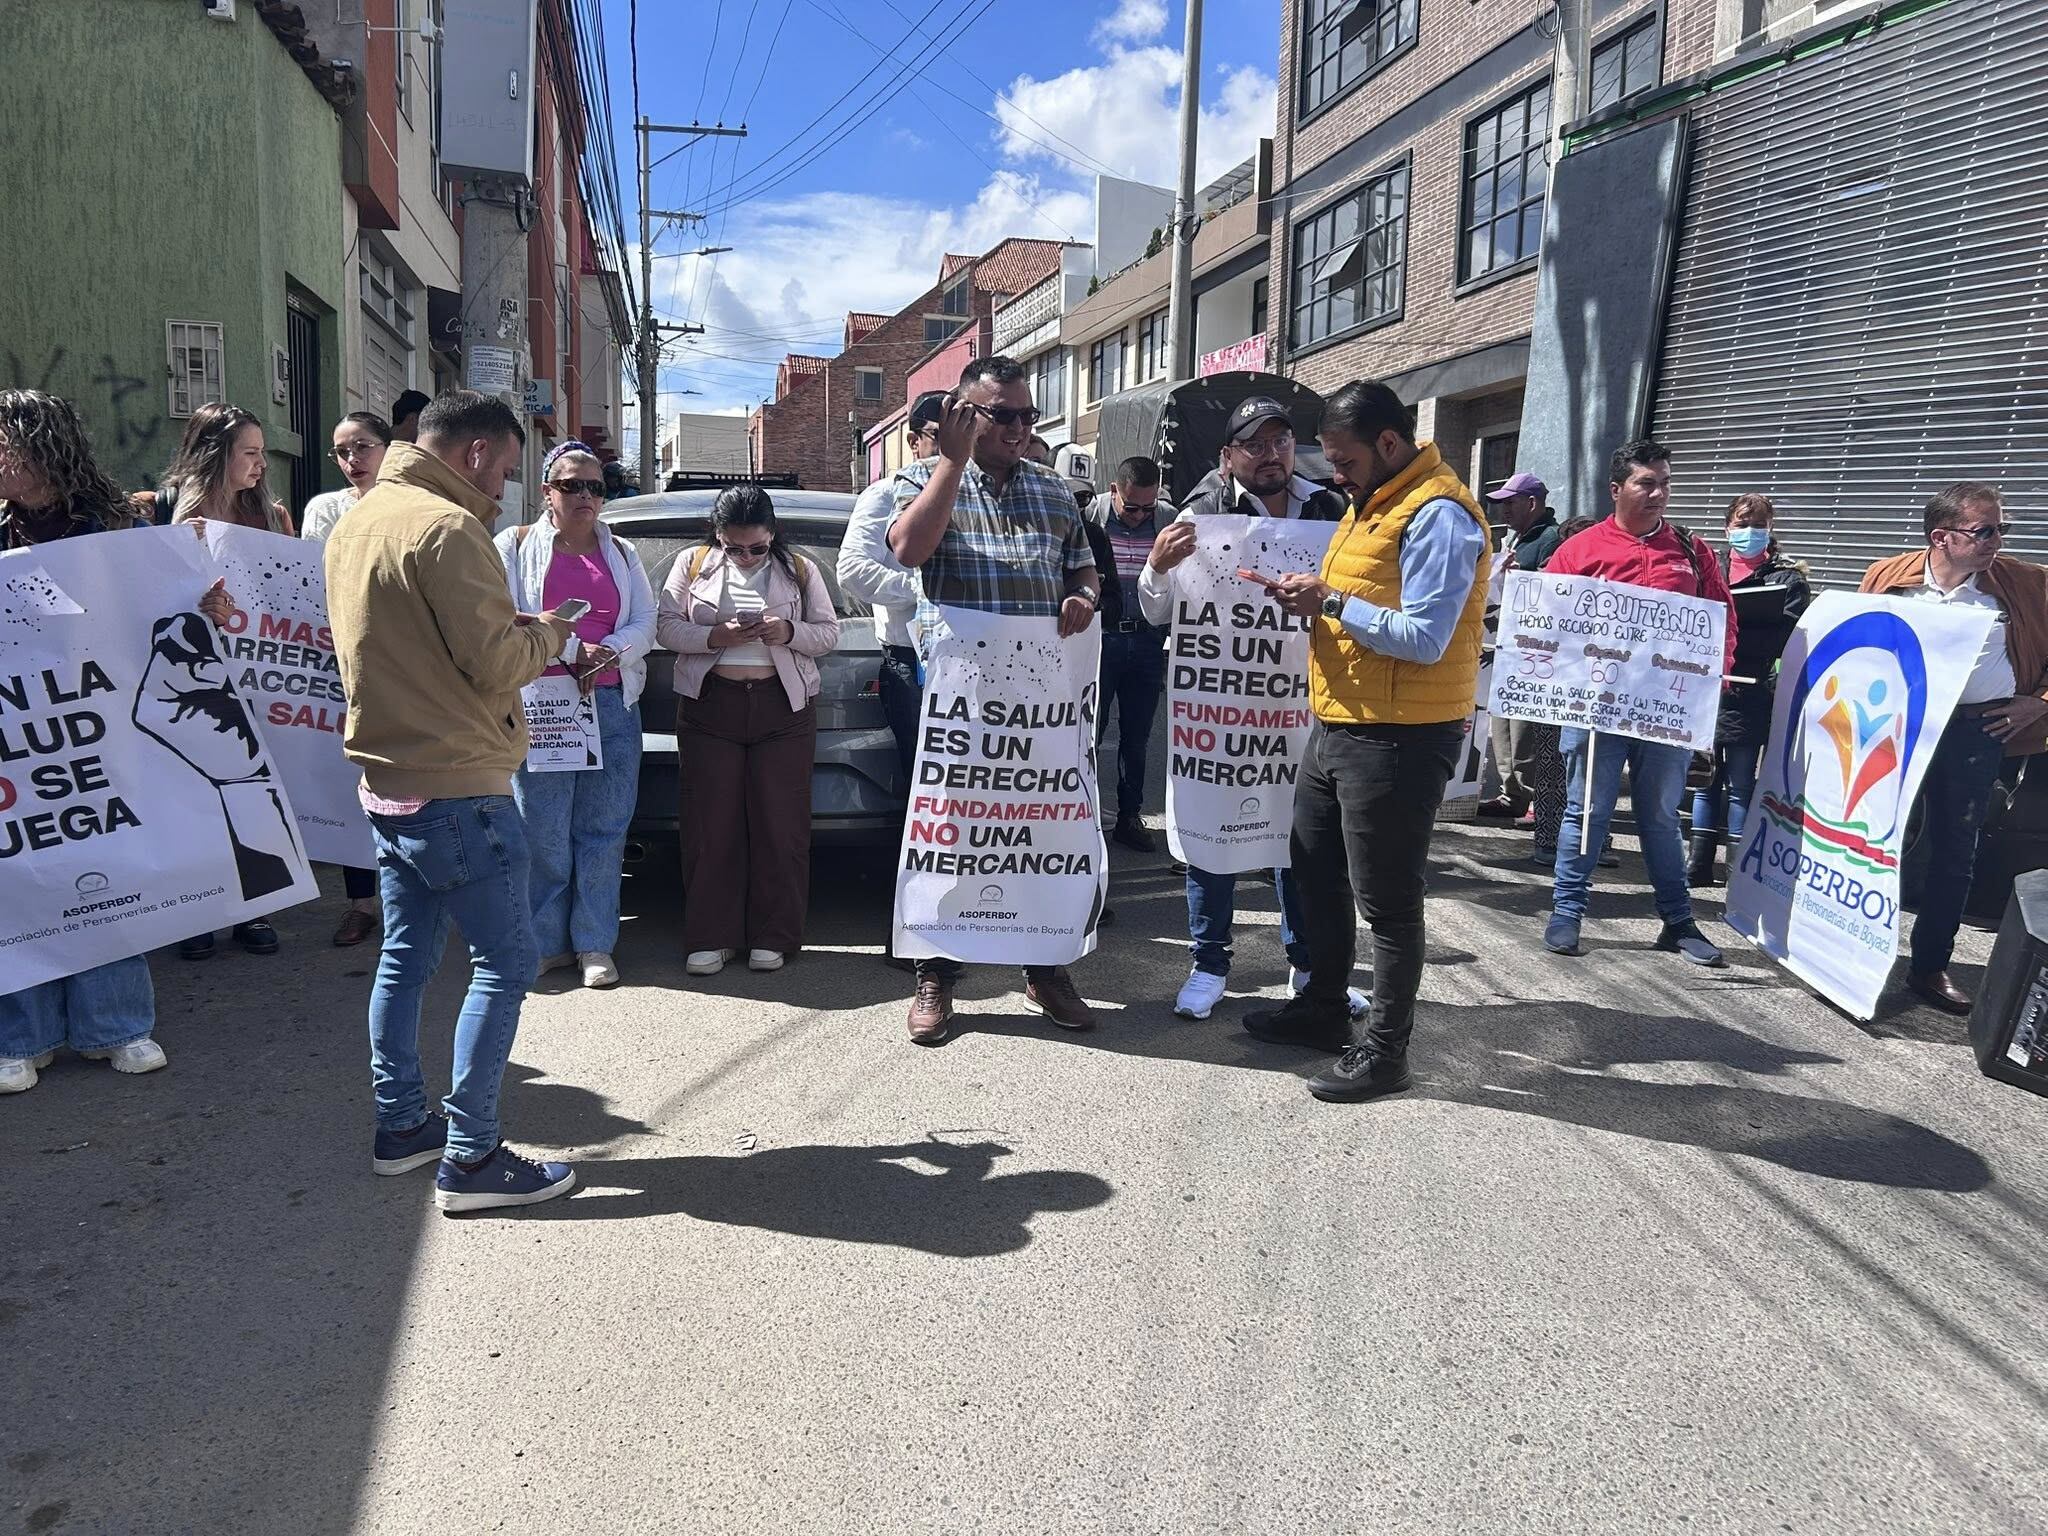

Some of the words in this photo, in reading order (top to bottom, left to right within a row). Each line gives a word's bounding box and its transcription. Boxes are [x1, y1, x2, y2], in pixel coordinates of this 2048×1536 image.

[1178, 600, 1220, 627] LA
[1574, 589, 1712, 639] AQUITANIA
[259, 613, 335, 652] MAS
[1519, 615, 1554, 630] HEMOS
[1558, 619, 1609, 636] RECIBIDO
[1614, 625, 1648, 643] ENTRE
[1176, 633, 1221, 660] ES
[1232, 636, 1283, 665] UN
[41, 660, 118, 705] LA
[1519, 651, 1554, 679] 33
[1591, 661, 1618, 685] 60
[1669, 675, 1688, 699] 4
[524, 700, 536, 708] LA
[538, 699, 570, 707] SALUD
[1506, 675, 1547, 693] PORQUE
[1552, 685, 1563, 696] LA
[1568, 687, 1596, 700] SALUD
[1618, 693, 1630, 705] ES
[1634, 697, 1648, 710] UN
[527, 716, 573, 725] DERECHO
[540, 708, 555, 716] UN
[927, 693, 970, 722] LA
[1173, 701, 1313, 729] FUNDAMEN
[1497, 687, 1530, 703] PORQUE
[1533, 696, 1543, 706] LA
[1546, 697, 1567, 709] VIDA
[1628, 708, 1663, 724] PORQUE
[1667, 717, 1684, 729] LOS
[1501, 701, 1547, 718] DERECHOS
[529, 733, 542, 742] NO
[544, 733, 563, 741] UNA
[529, 741, 583, 750] MERCANCIA
[923, 727, 970, 756] ES
[981, 733, 1032, 761] UN
[1173, 725, 1216, 753] NO
[1225, 732, 1288, 757] UNA
[31, 755, 110, 801] SE
[919, 761, 1080, 793] DERECHO
[1172, 754, 1298, 788] MERCAN
[913, 796, 1092, 821] FUNDAMENTAL
[910, 820, 960, 847] NO
[969, 825, 1032, 848] UNA
[1215, 836, 1228, 845] de
[1277, 832, 1289, 840] de
[1220, 820, 1271, 833] ASOPERBOY
[905, 848, 1092, 876] MERCANCIA
[1740, 816, 1898, 930] ASOPERBOY
[62, 893, 142, 919] ASOPERBOY
[63, 922, 80, 934] de
[82, 903, 158, 929] Personerías
[161, 898, 178, 909] de
[179, 885, 225, 905] Boyacá
[958, 910, 1018, 921] ASOPERBOY
[902, 922, 952, 932] Asociación
[955, 923, 967, 932] de
[969, 923, 1024, 933] Personerías
[1026, 925, 1039, 934] de
[1847, 918, 1860, 936] de
[504, 1171, 514, 1182] T
